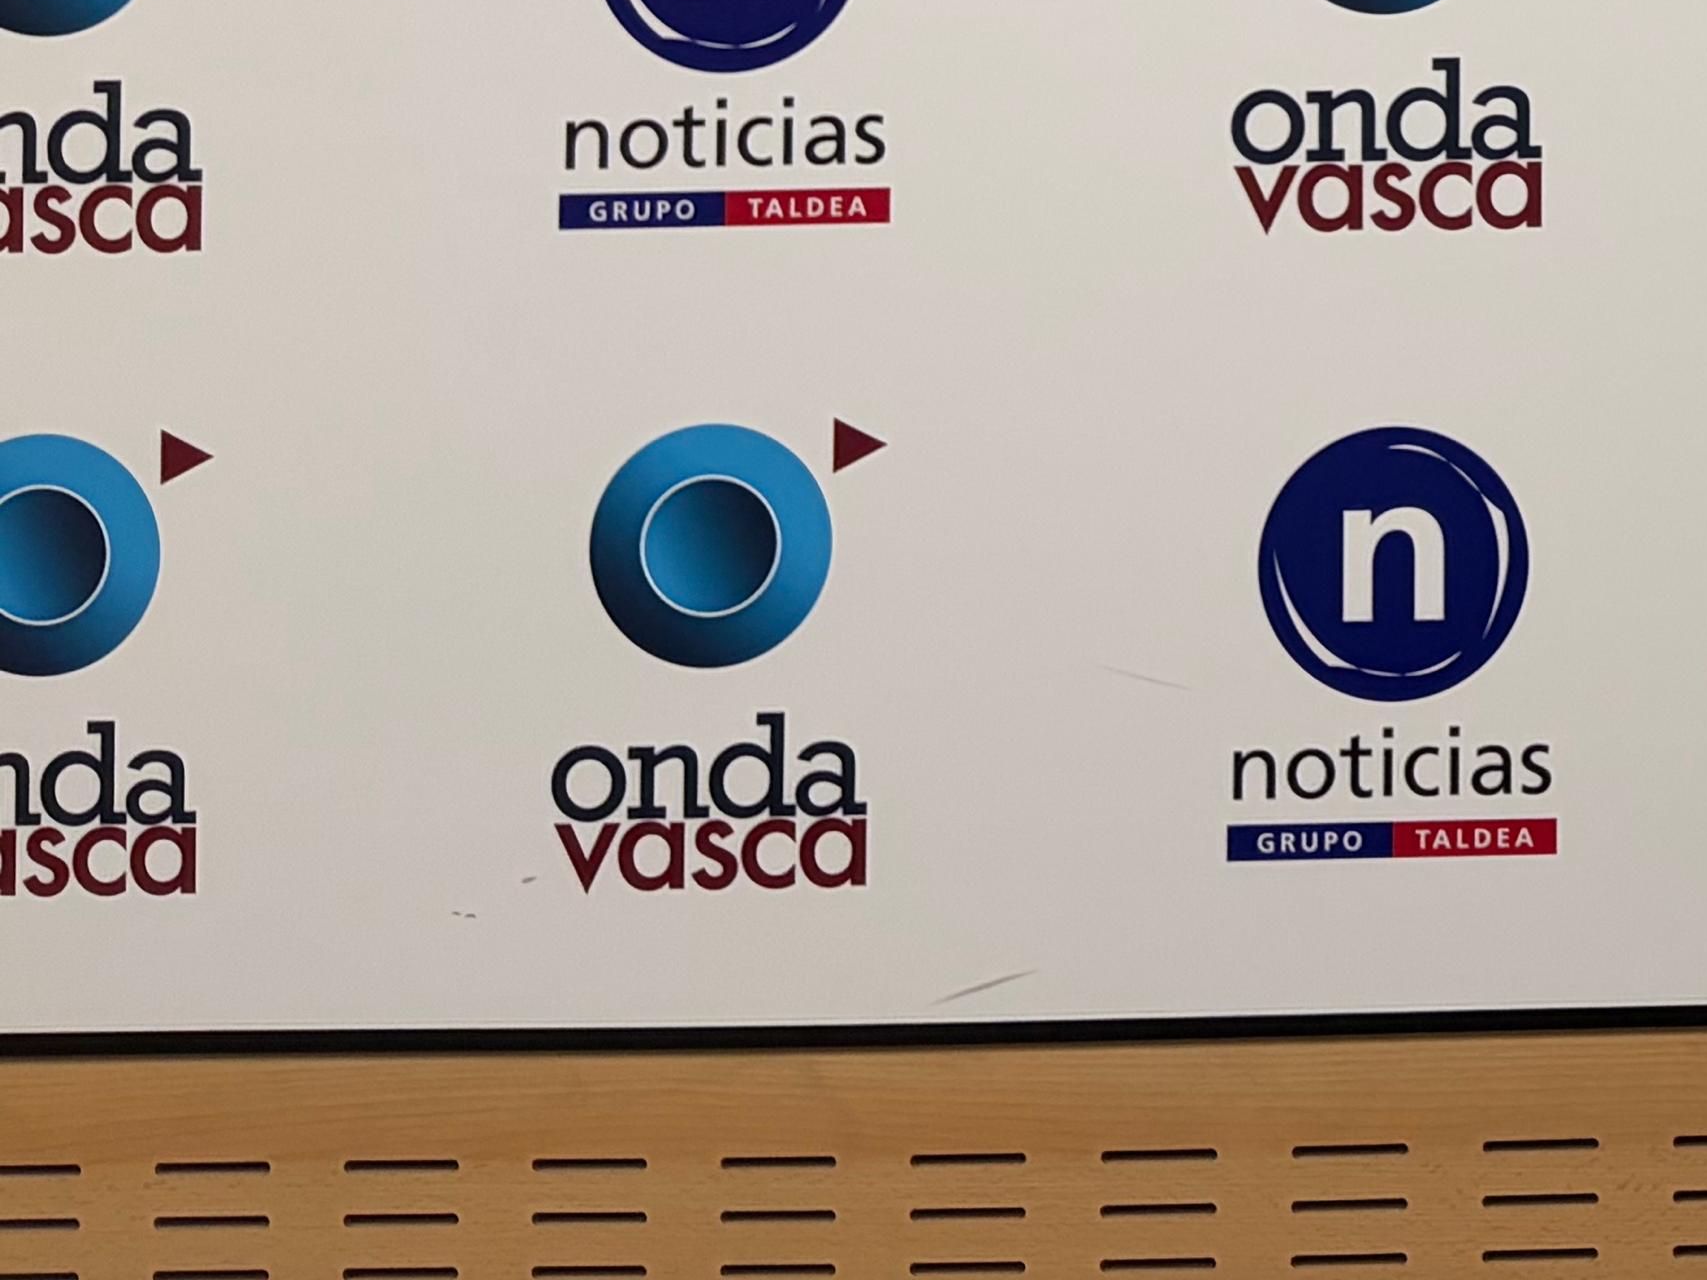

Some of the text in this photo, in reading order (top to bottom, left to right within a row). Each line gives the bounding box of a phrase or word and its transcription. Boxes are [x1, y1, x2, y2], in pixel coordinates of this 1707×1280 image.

[0, 80, 202, 184] nda
[565, 97, 884, 169] noticias
[1231, 57, 1541, 164] onda
[588, 195, 867, 222] GRUPO TALDEA
[1233, 160, 1541, 235] vasca
[1341, 504, 1445, 622] n
[551, 712, 867, 822] onda
[1232, 727, 1552, 801] noticias
[553, 818, 867, 894] vasca
[1256, 826, 1534, 854] GRUPO TALDEA
